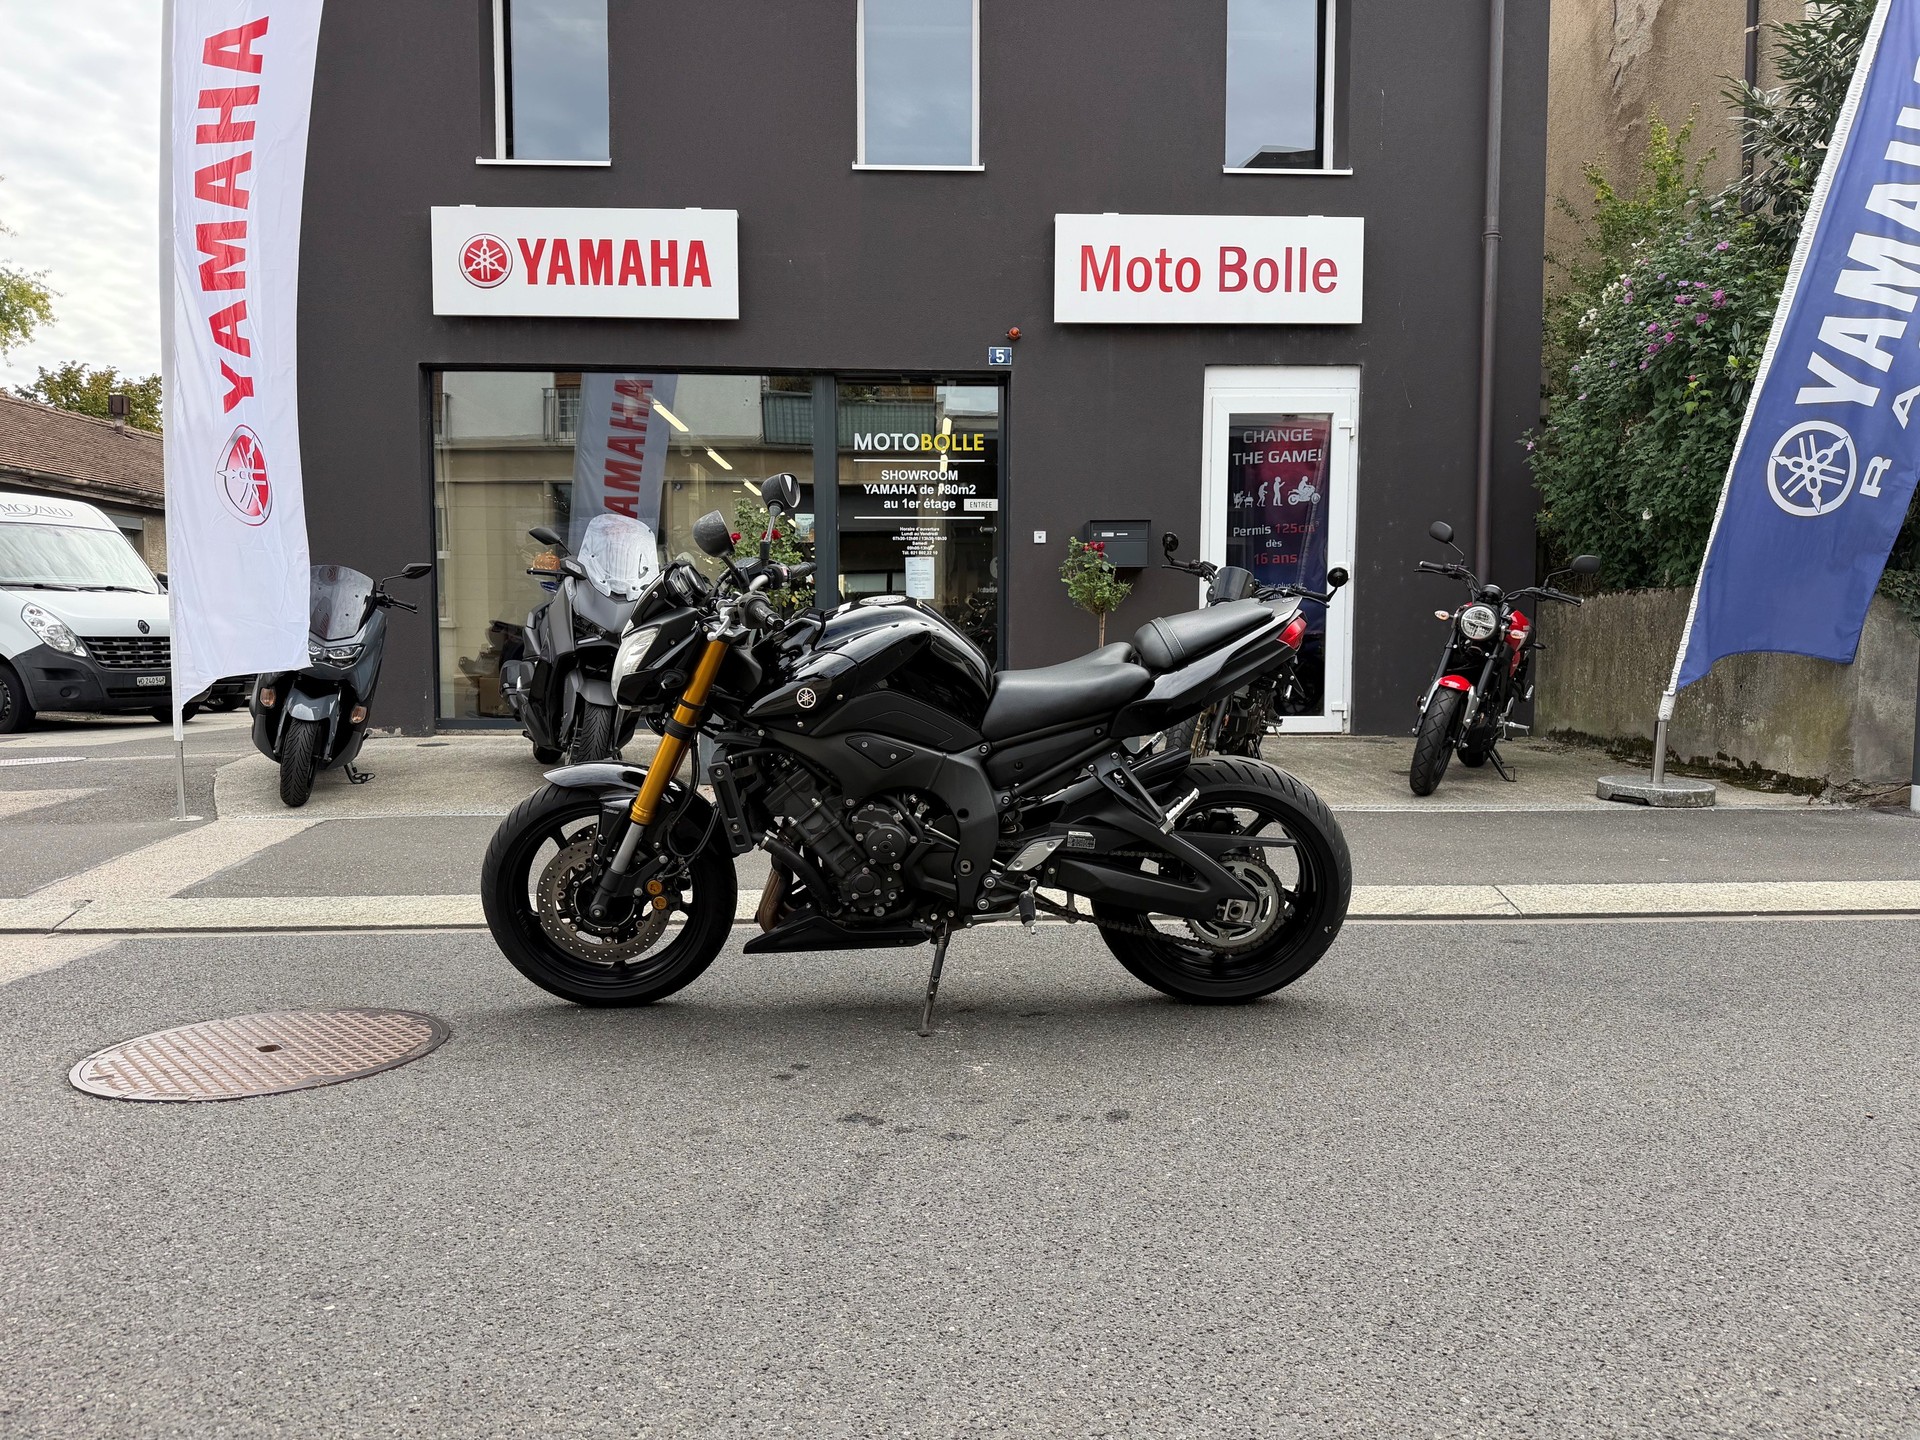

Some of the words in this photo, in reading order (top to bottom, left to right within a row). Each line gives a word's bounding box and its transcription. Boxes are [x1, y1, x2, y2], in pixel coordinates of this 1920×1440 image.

[195, 15, 270, 415] YAMAHA
[517, 238, 712, 287] YAMAHA
[1080, 245, 1201, 293] Moto
[1218, 246, 1338, 293] Bolle
[995, 349, 1005, 363] 5
[853, 432, 985, 451] MOTOBOLLE
[1243, 428, 1313, 444] CHANGE
[1232, 450, 1264, 466] THE
[1268, 448, 1322, 463] GAME!
[881, 469, 959, 481] SHOWROOM
[863, 483, 917, 494] YAMAHA
[919, 483, 934, 495] de
[883, 500, 898, 509] au
[901, 498, 921, 509] 1er
[923, 498, 956, 511] étage
[969, 501, 993, 509] ENTRÉE
[1233, 524, 1272, 537] Permis
[1265, 539, 1283, 548] dès
[1254, 552, 1269, 565] 16
[1271, 553, 1298, 564] ans
